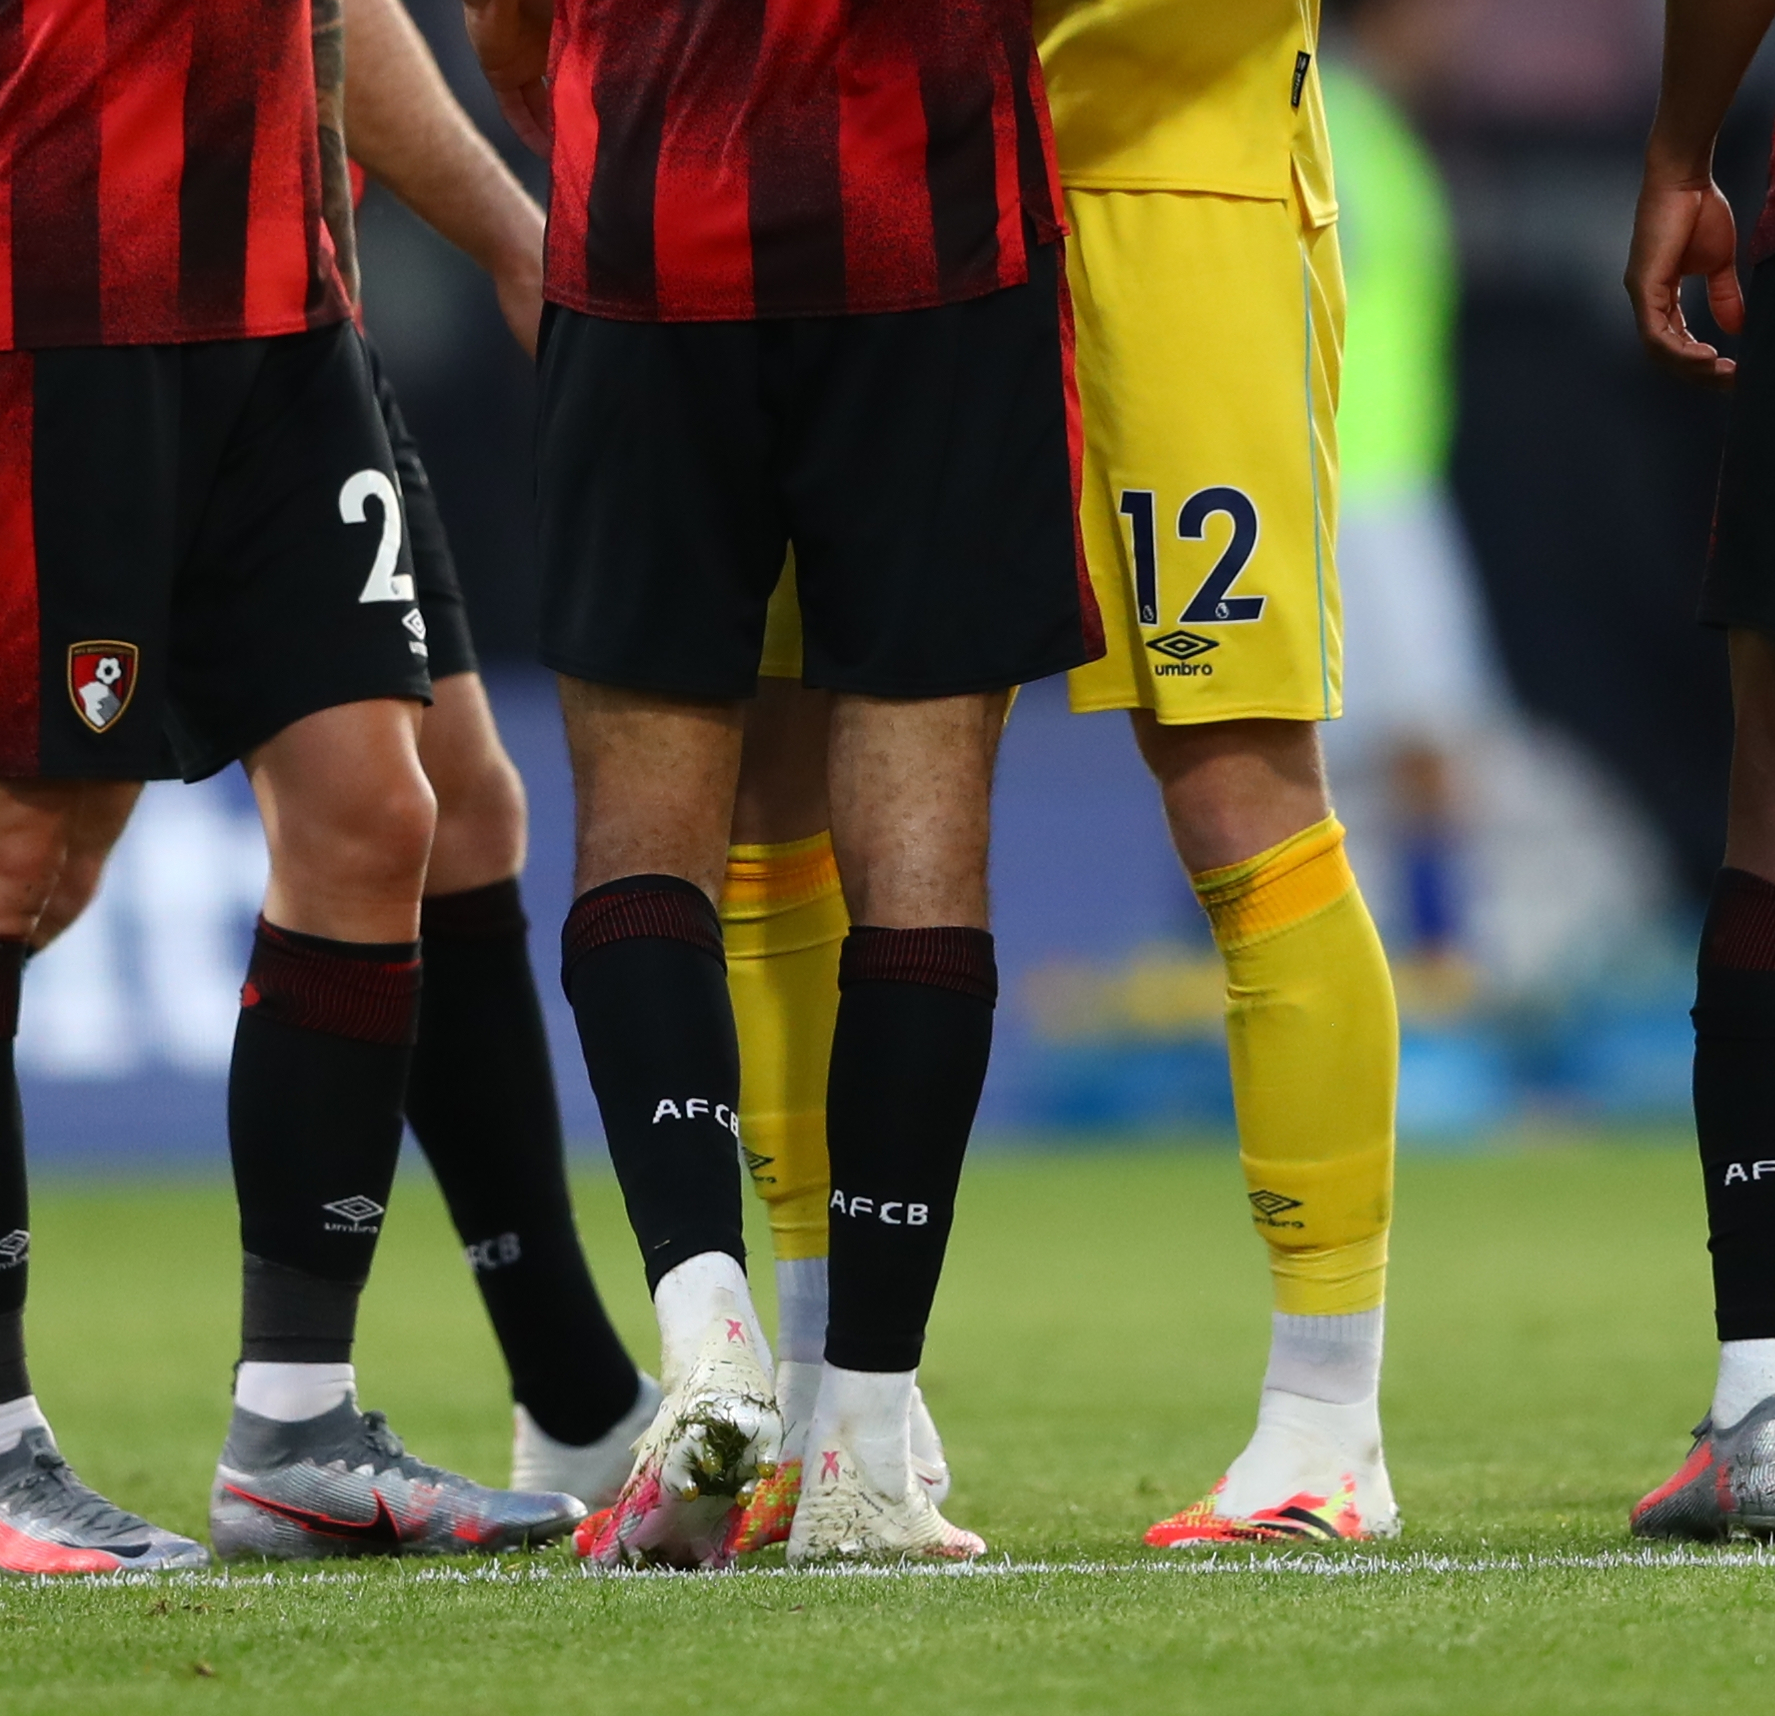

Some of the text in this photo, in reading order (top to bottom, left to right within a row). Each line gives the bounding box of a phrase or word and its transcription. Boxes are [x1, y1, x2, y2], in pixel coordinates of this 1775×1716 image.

[338, 467, 415, 604] 2
[1119, 486, 1267, 626] 12
[1154, 662, 1213, 676] umbro
[652, 1087, 739, 1137] AFCB
[830, 1189, 929, 1226] AFCB
